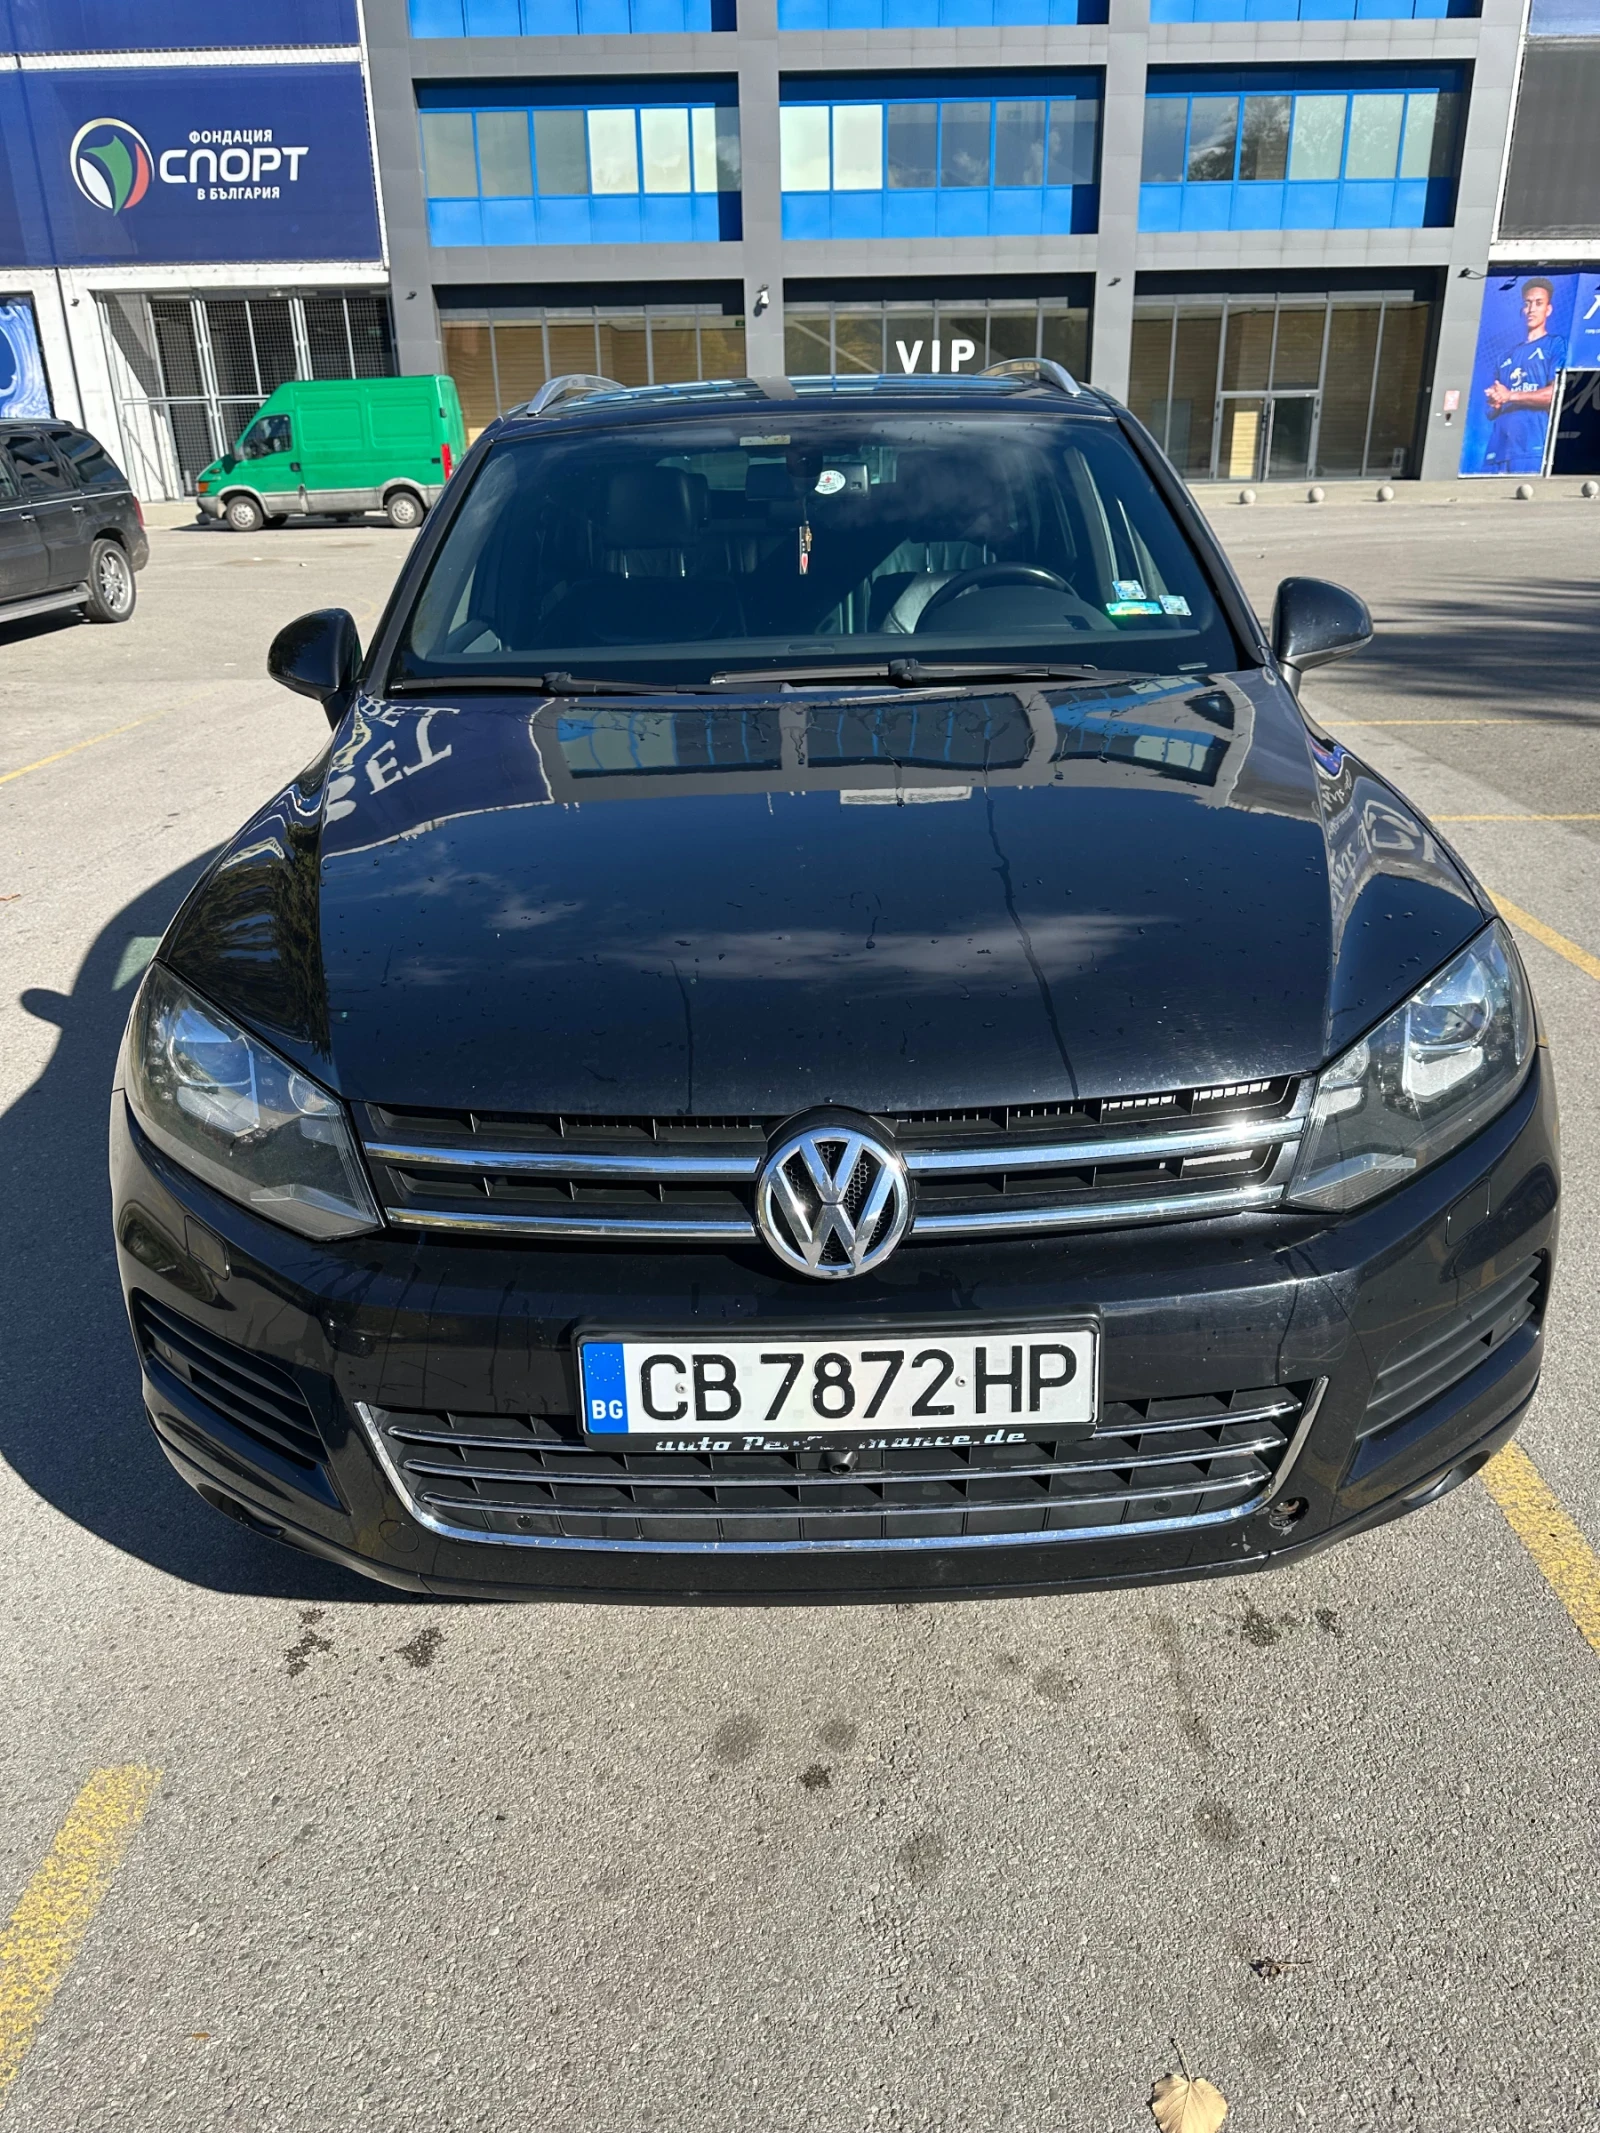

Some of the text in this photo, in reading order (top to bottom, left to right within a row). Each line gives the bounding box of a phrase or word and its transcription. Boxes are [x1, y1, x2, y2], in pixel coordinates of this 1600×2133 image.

[189, 129, 273, 145] ФОНДАЦИЯ
[159, 147, 309, 183] СПОРТ
[197, 187, 280, 200] В БЪЛГАРИЯ
[895, 339, 975, 374] VIP
[640, 1343, 1077, 1421] CB 7872 HP
[592, 1400, 623, 1419] BG
[655, 1436, 732, 1451] auto
